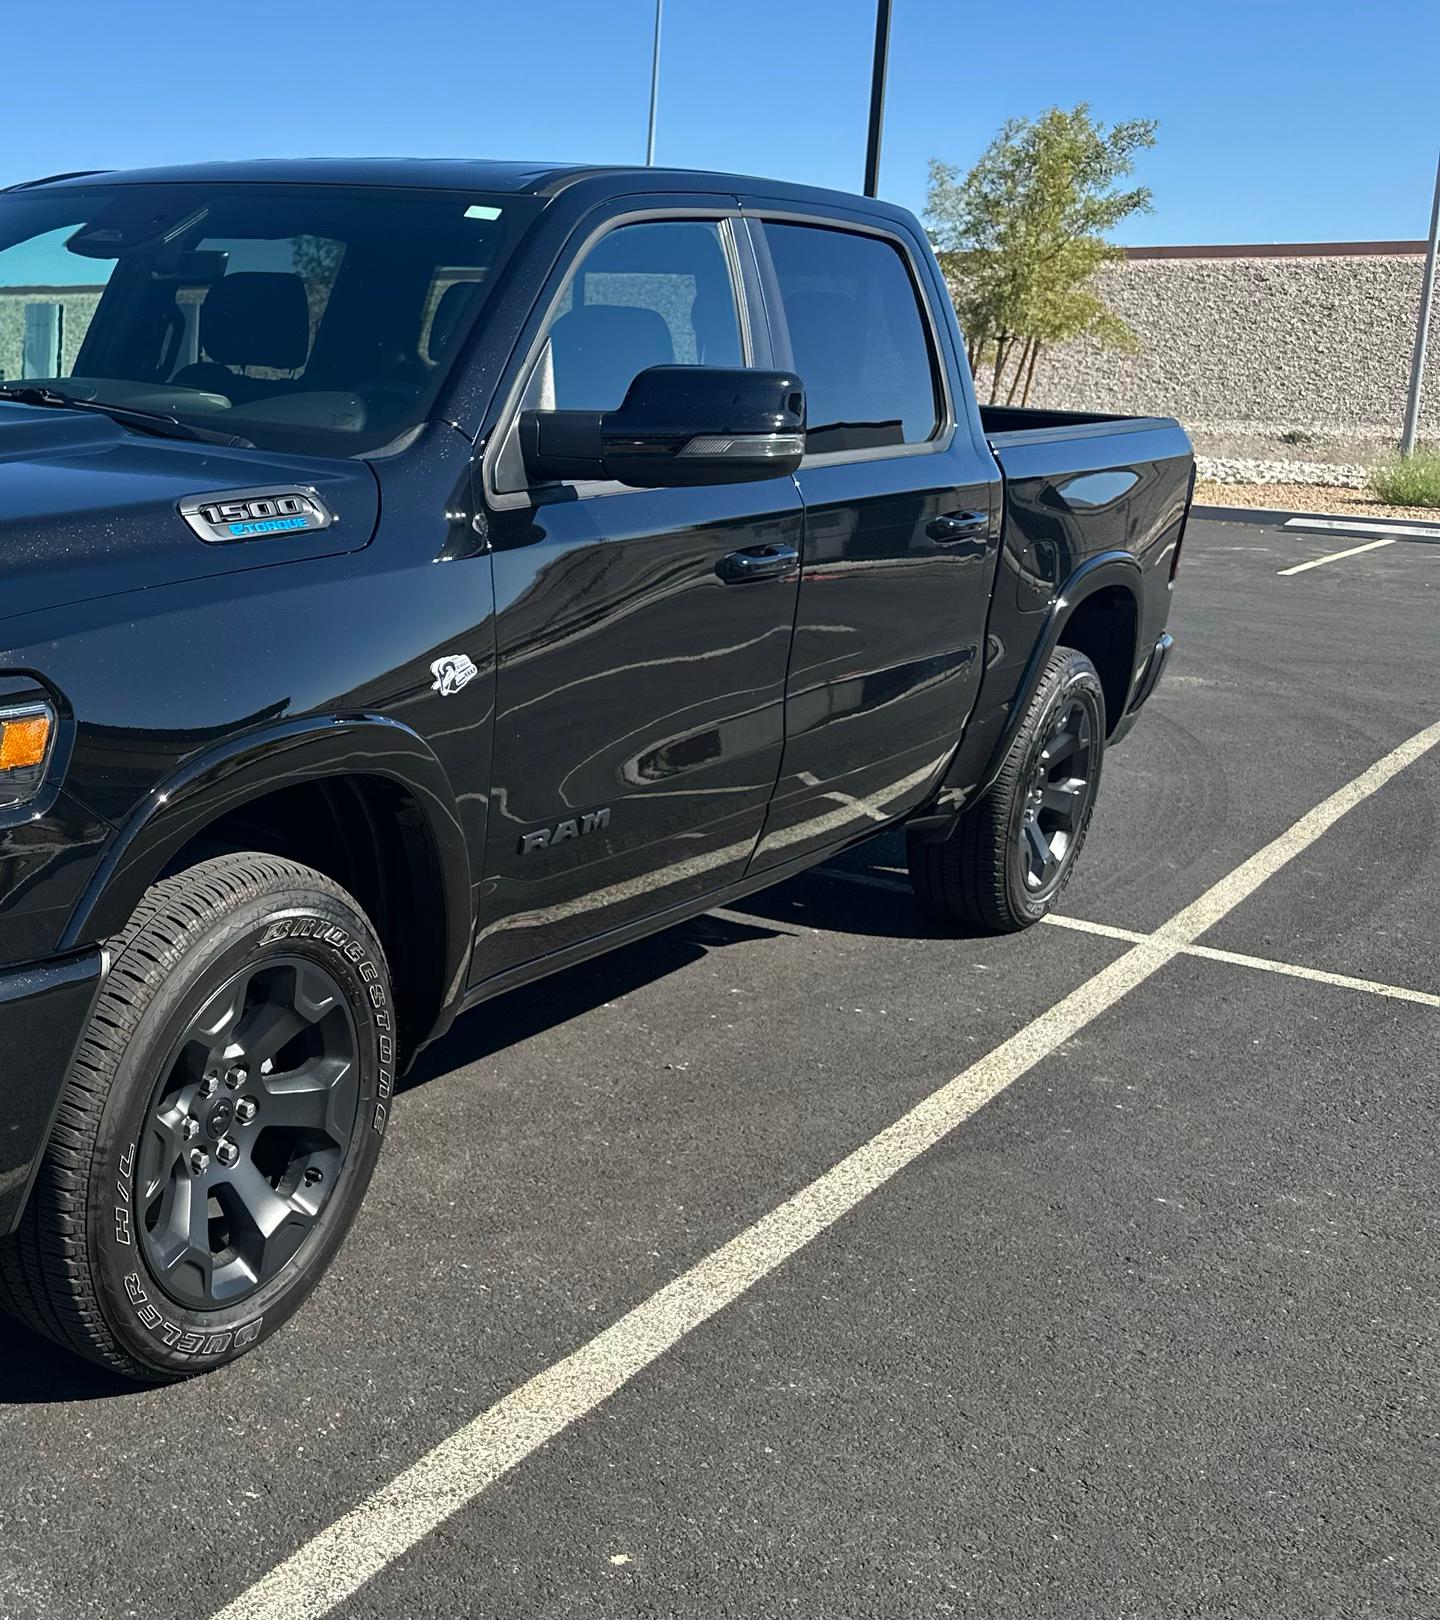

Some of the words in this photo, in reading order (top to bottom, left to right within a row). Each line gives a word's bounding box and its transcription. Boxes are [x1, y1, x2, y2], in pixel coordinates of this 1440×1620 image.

[204, 496, 301, 524] 1500
[518, 808, 611, 856] RAM
[257, 918, 392, 1136] BRIDGESTONE
[124, 1273, 263, 1355] DUELER
